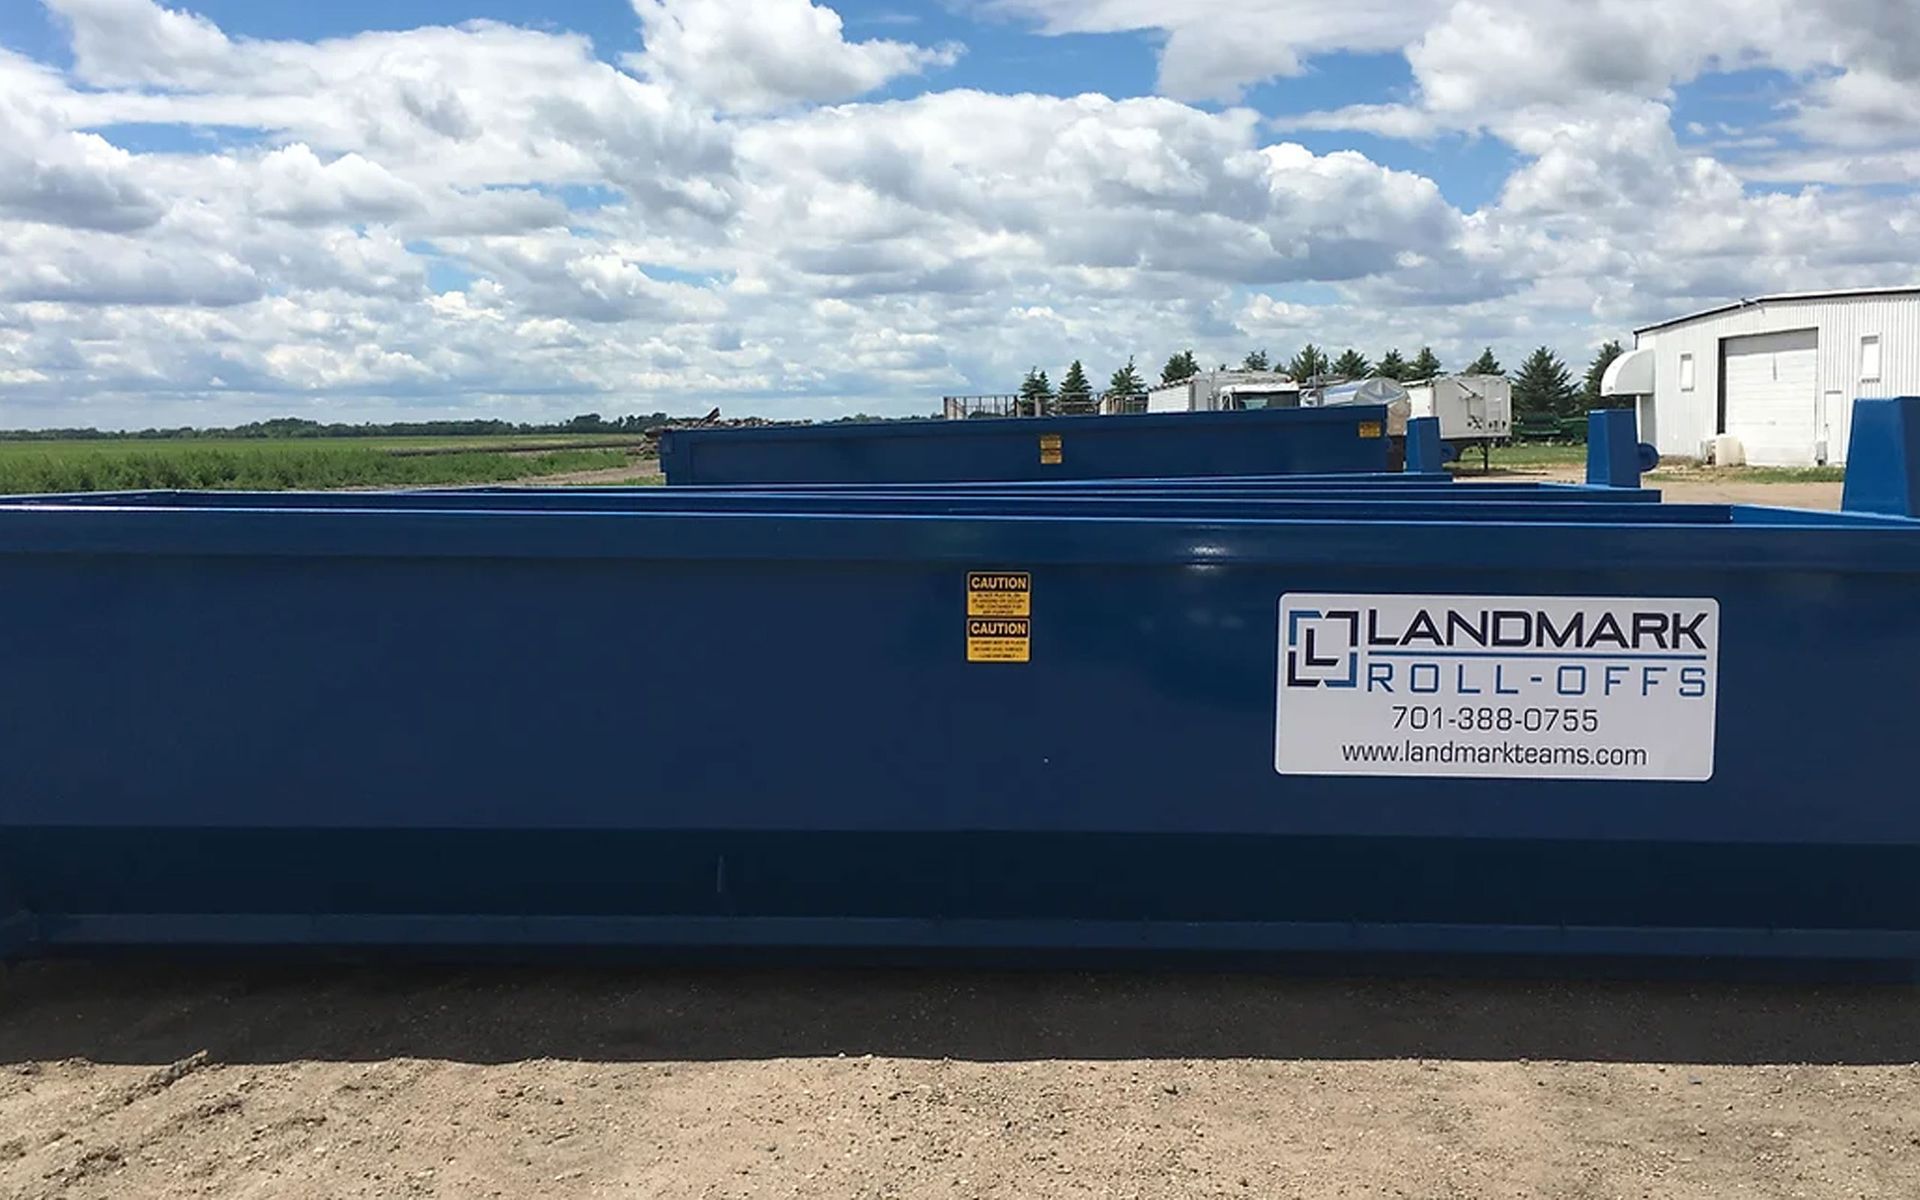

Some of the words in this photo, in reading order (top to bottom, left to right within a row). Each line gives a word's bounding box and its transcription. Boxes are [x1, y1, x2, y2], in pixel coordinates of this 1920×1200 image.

[971, 577, 1027, 589] CAUTION
[971, 622, 1026, 635] CAUTION
[1367, 608, 1709, 649] LANDMARK
[1367, 662, 1706, 697] ROLL-OFFS
[1391, 706, 1599, 732] 701-388-0755
[1341, 740, 1647, 766] www.landmarkteams.com
